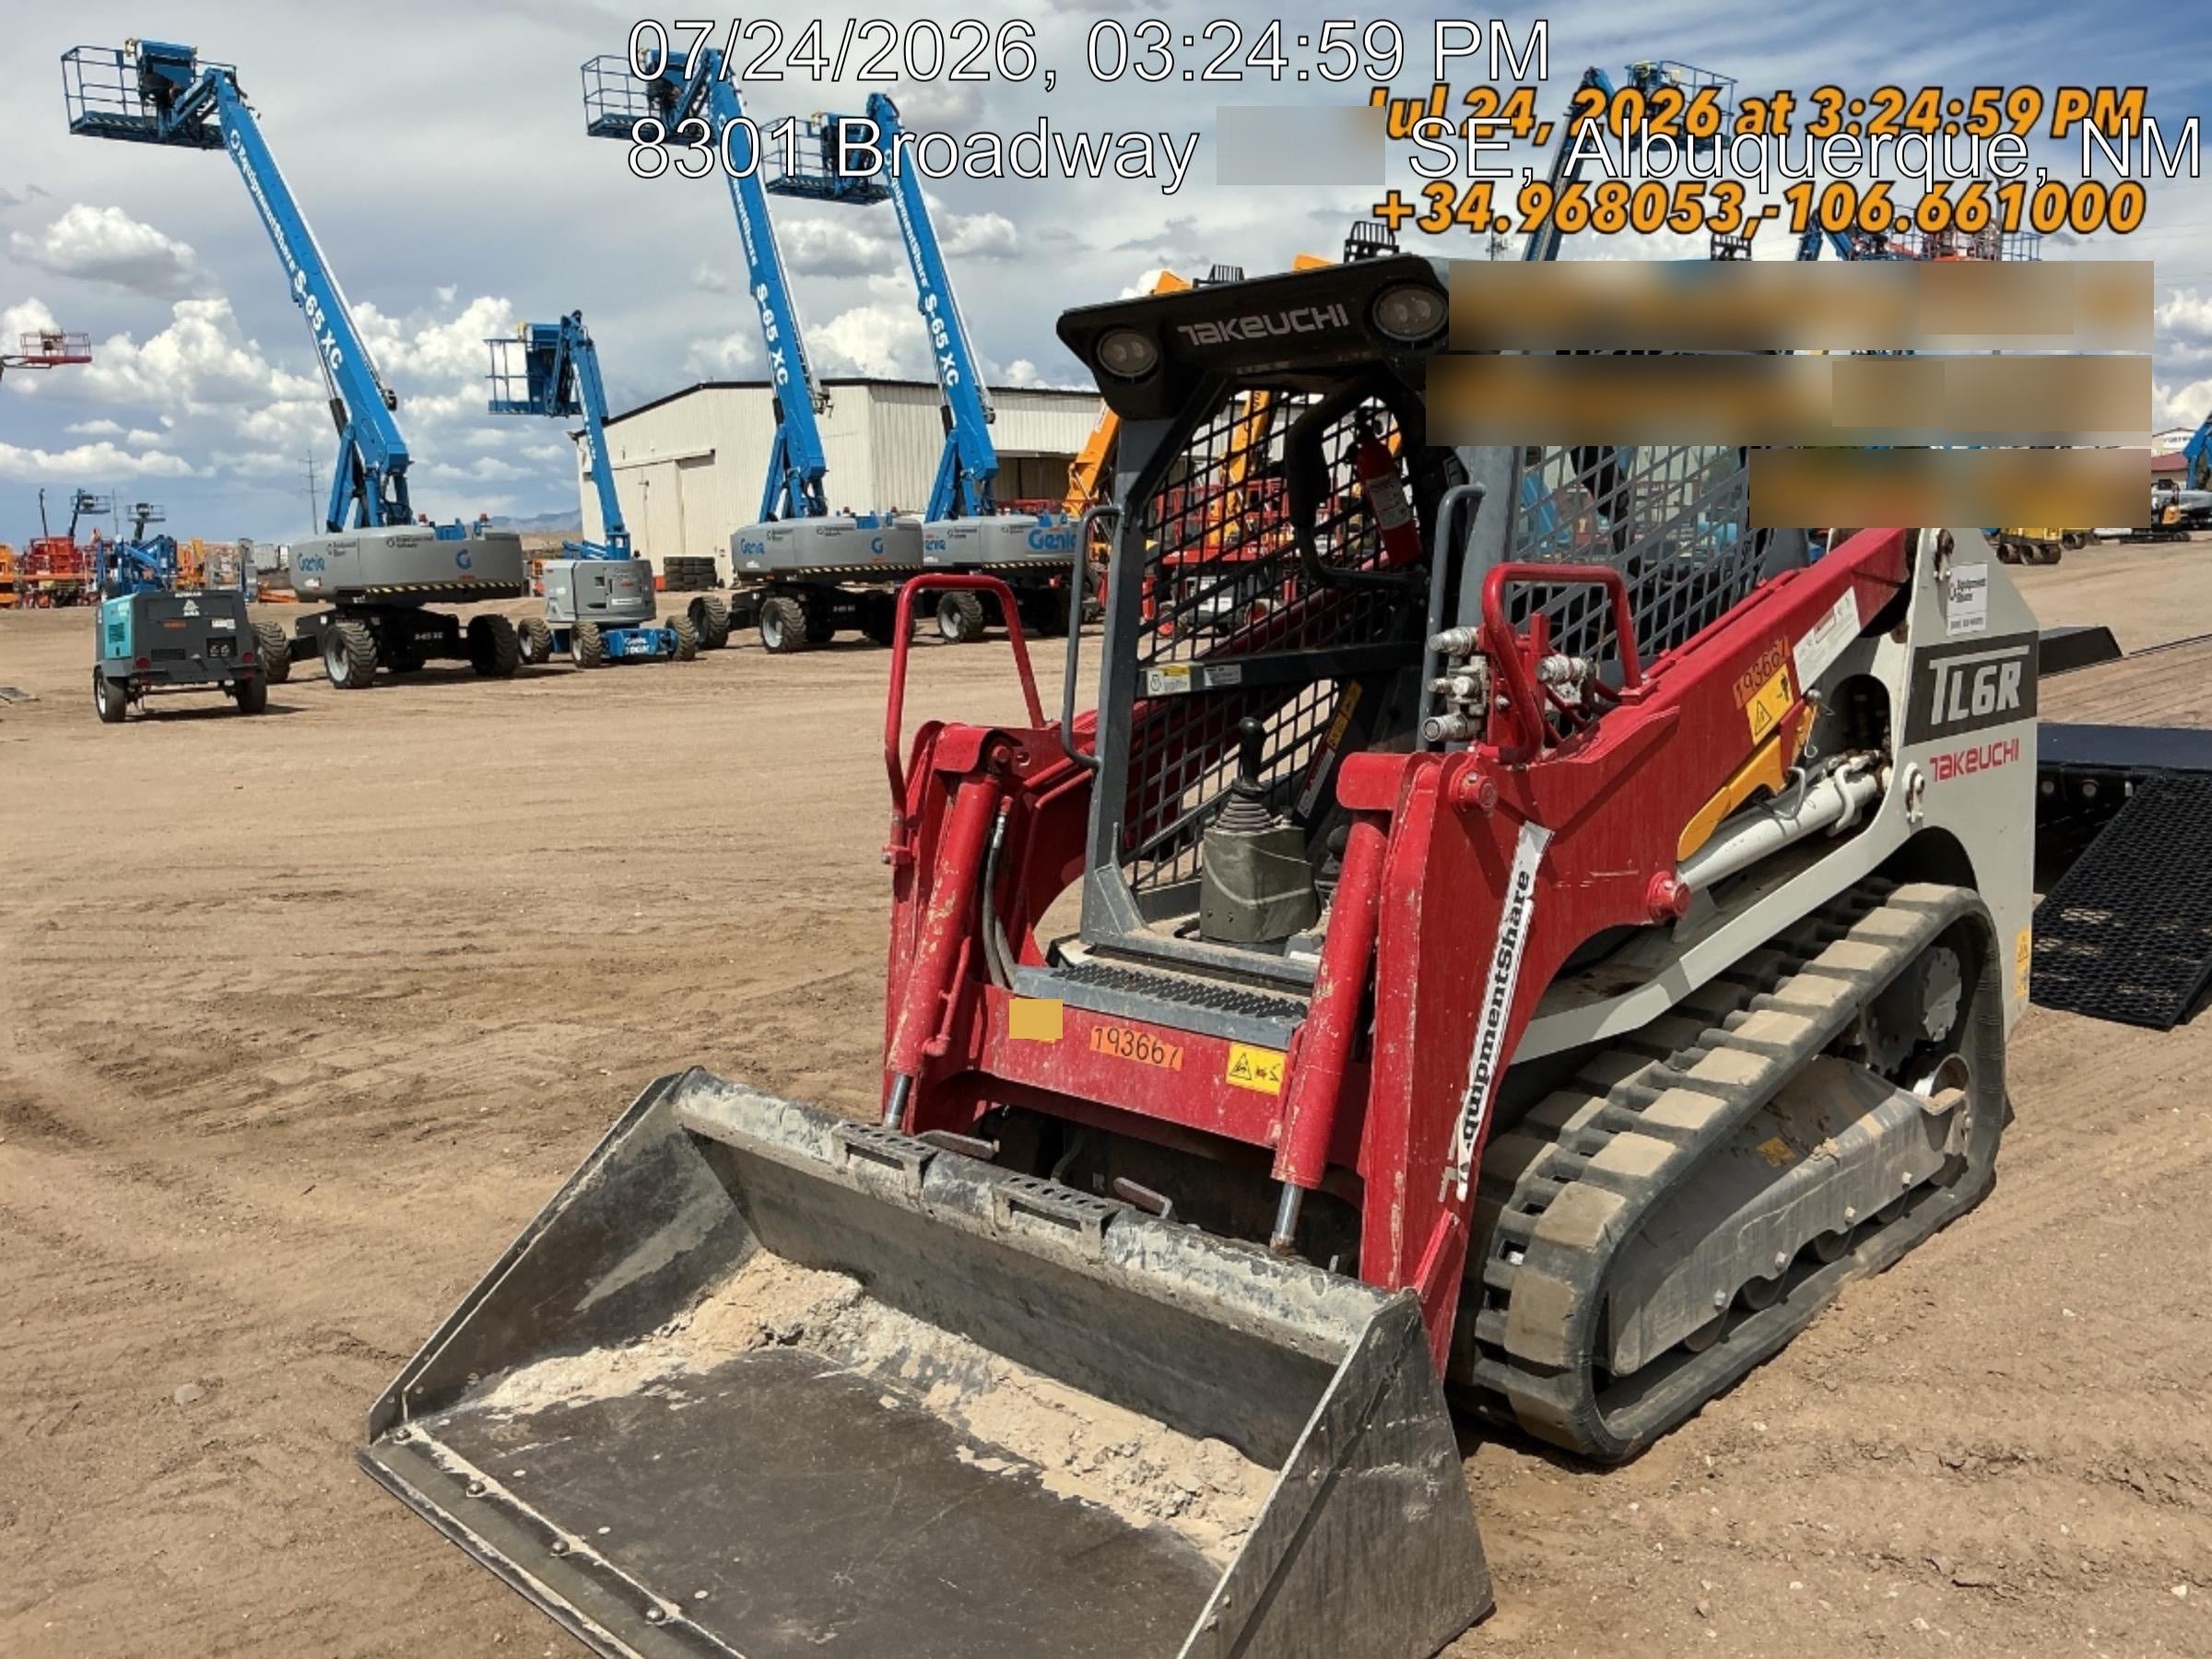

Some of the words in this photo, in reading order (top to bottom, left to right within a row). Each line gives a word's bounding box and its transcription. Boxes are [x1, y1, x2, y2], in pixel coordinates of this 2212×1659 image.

[294, 269, 325, 332] S-65
[321, 327, 344, 371] XC
[756, 283, 779, 342] S-65
[771, 346, 789, 385] XC
[924, 292, 950, 349] S-65
[939, 352, 959, 387] XC
[1928, 644, 2030, 726] TL6R
[1462, 869, 1531, 1149] quipmentShare
